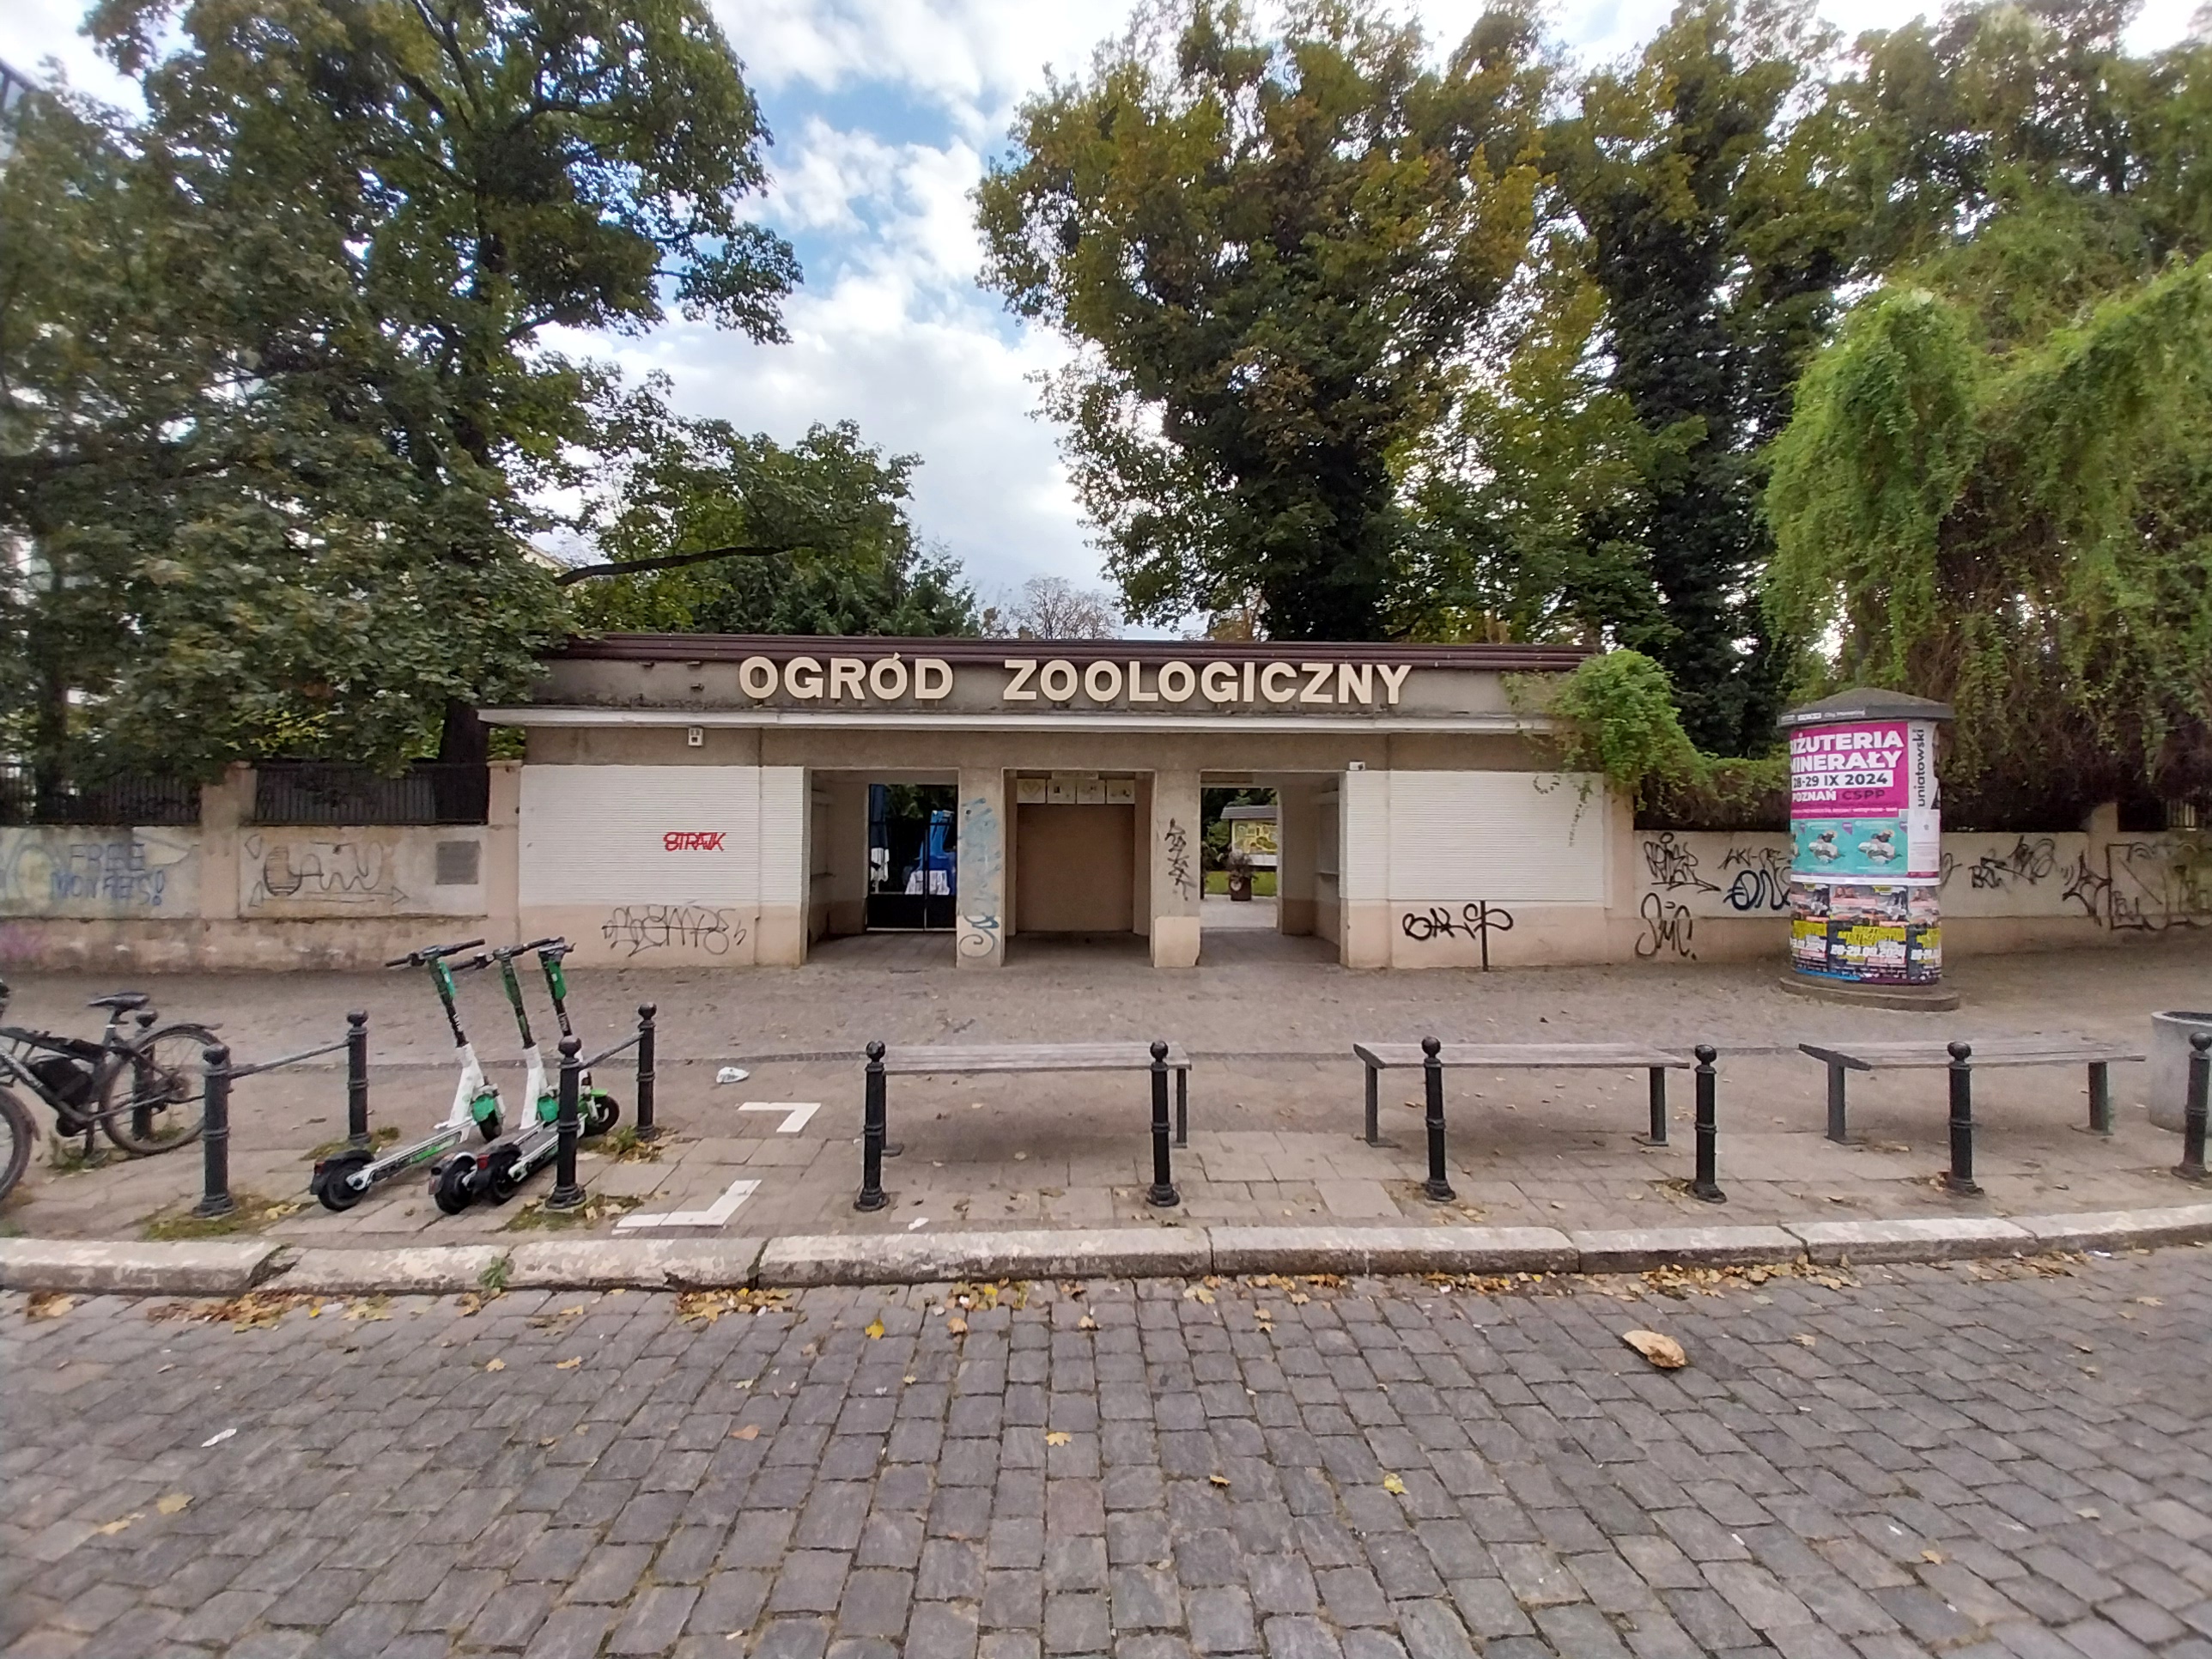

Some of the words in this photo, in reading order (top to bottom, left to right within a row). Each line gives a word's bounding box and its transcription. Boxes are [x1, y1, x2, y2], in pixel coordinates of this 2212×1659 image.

[739, 653, 953, 700] OGRÓD
[1003, 659, 1412, 704] ZOOLOGICZNY
[1824, 775, 1839, 787] IX
[1844, 773, 1887, 786] 2024
[1912, 729, 1925, 807] uniatowski
[1792, 787, 1837, 802] POZNAŃ
[1842, 789, 1885, 800] CSPP
